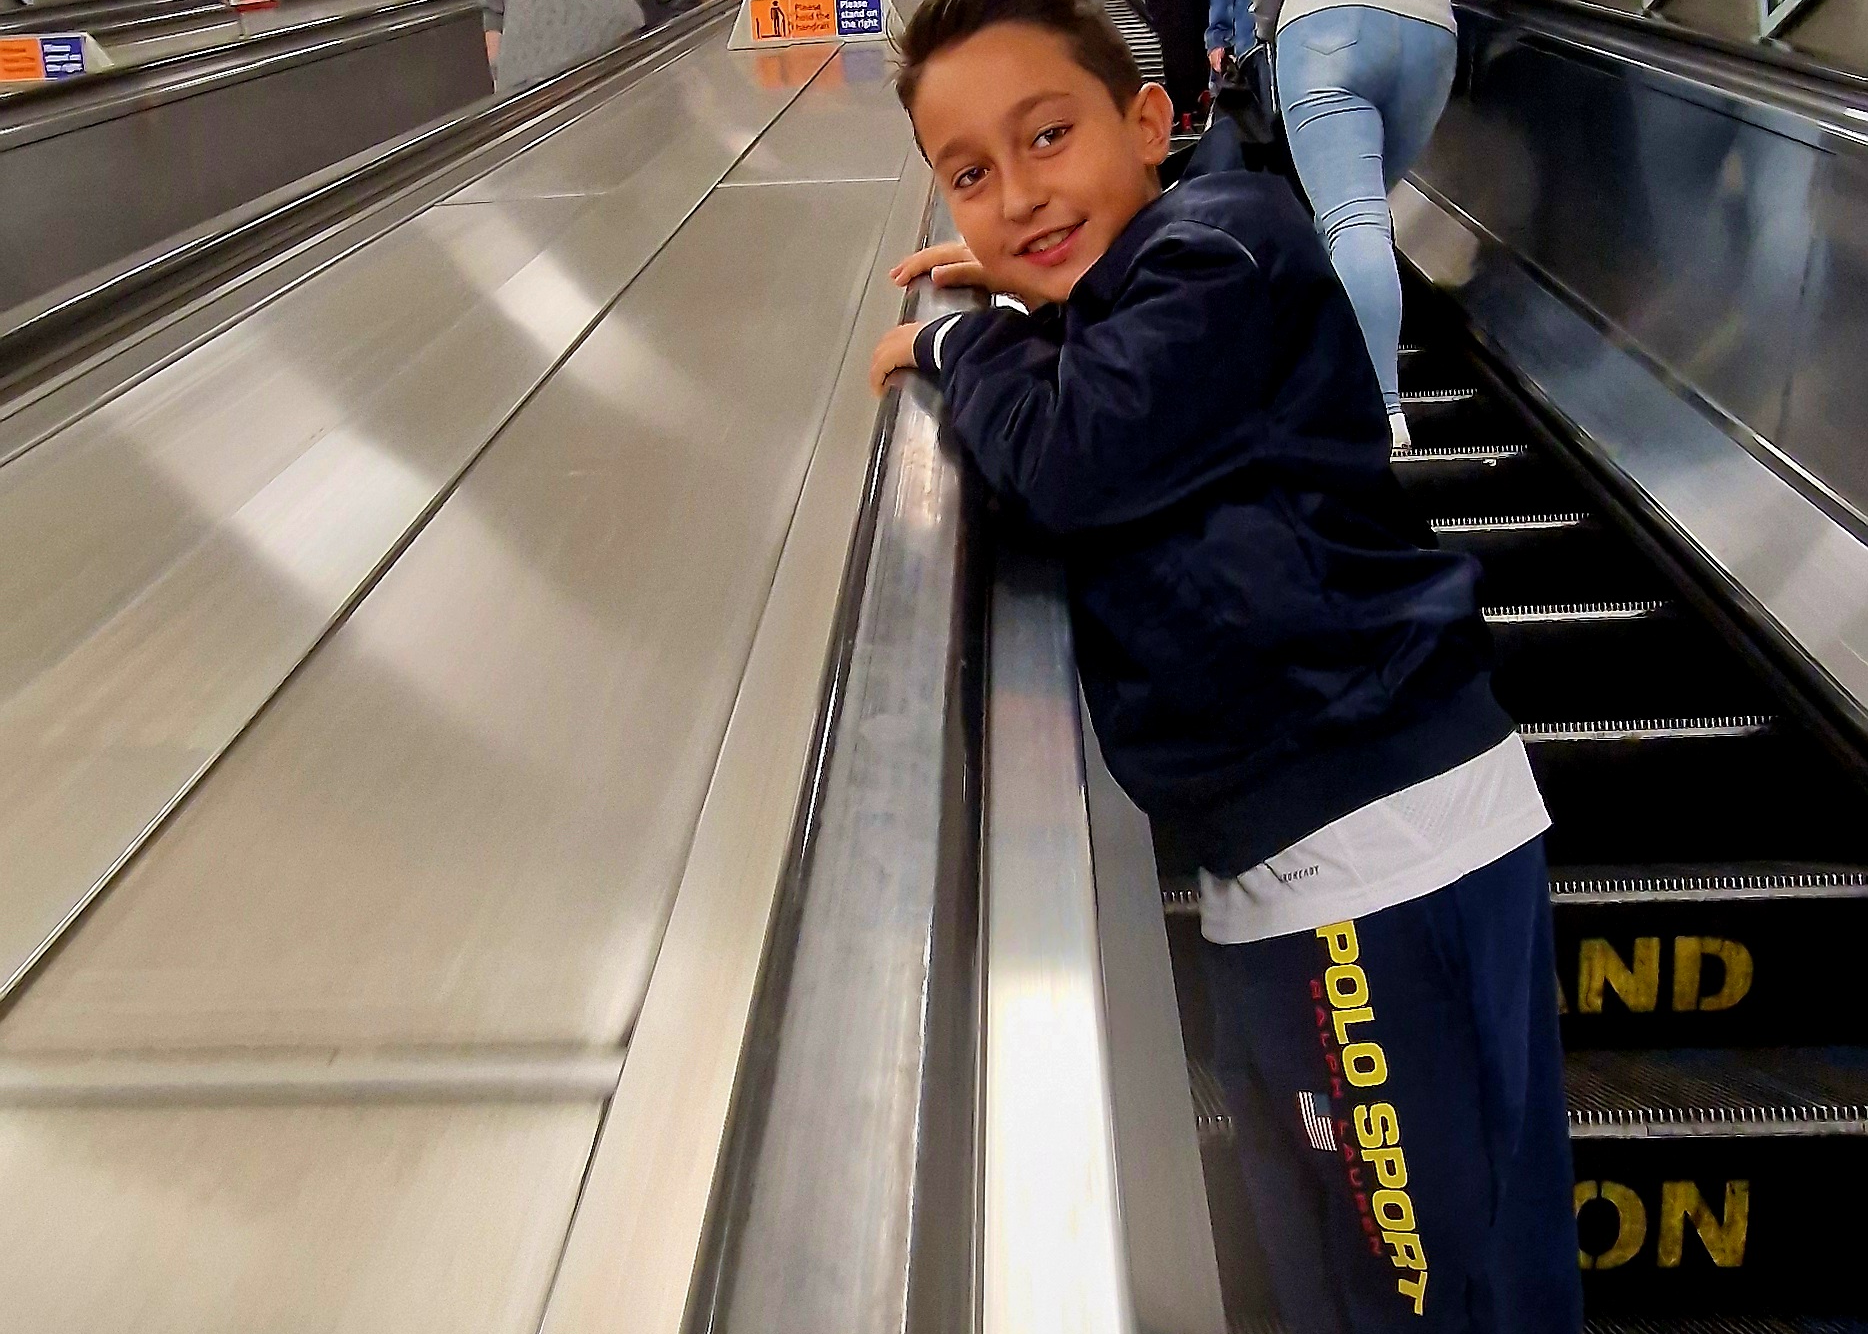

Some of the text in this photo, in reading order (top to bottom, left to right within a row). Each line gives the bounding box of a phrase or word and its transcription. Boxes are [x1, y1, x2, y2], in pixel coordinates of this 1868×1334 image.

[839, 0, 868, 9] Please
[841, 9, 864, 18] stand
[858, 18, 879, 29] right
[1555, 935, 1755, 1015] ND
[1308, 977, 1383, 1258] RALPH LAUREN
[1314, 919, 1430, 1317] POLO SPORT
[1572, 1178, 1751, 1271] ON
